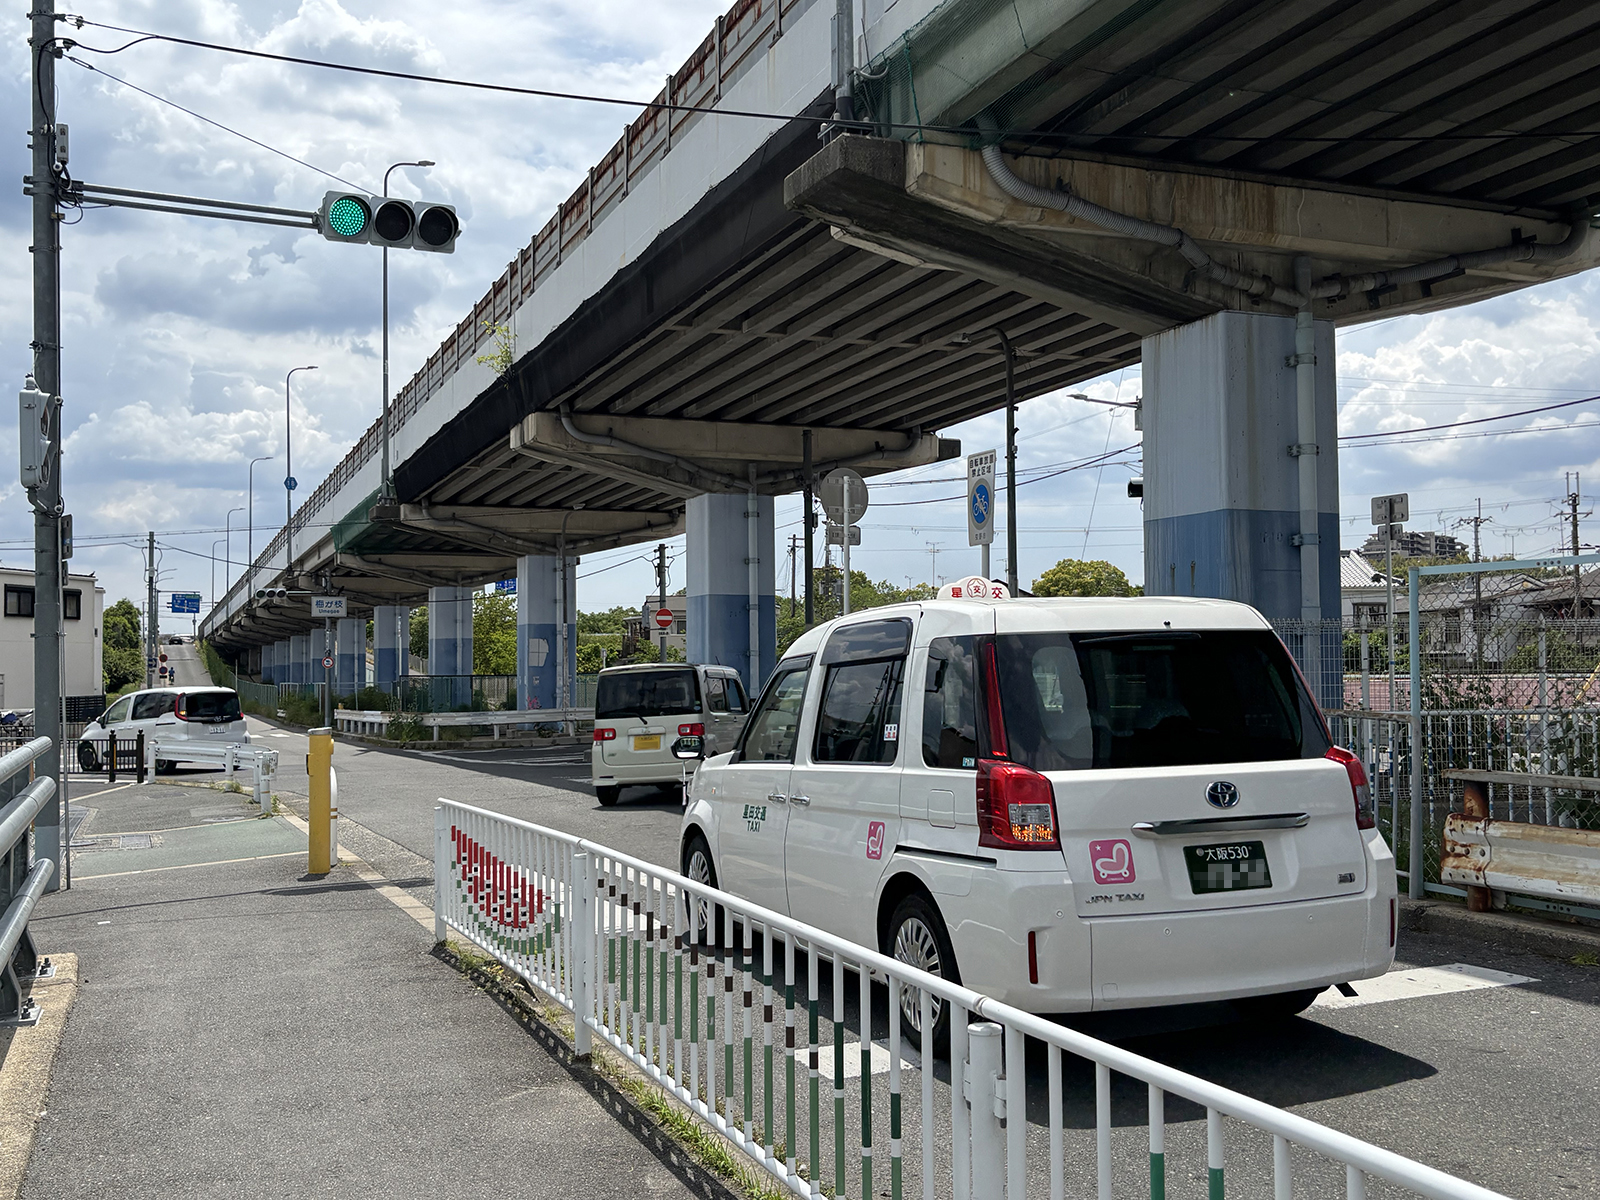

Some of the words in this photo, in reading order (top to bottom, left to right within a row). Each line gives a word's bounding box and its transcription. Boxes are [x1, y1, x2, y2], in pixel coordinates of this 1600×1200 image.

[951, 587, 963, 598] 星
[991, 586, 1003, 599] 交
[742, 804, 767, 821] 星田交通
[747, 820, 760, 832] TAXI
[1085, 894, 1113, 904] JPN
[1115, 893, 1145, 902] TAXI
